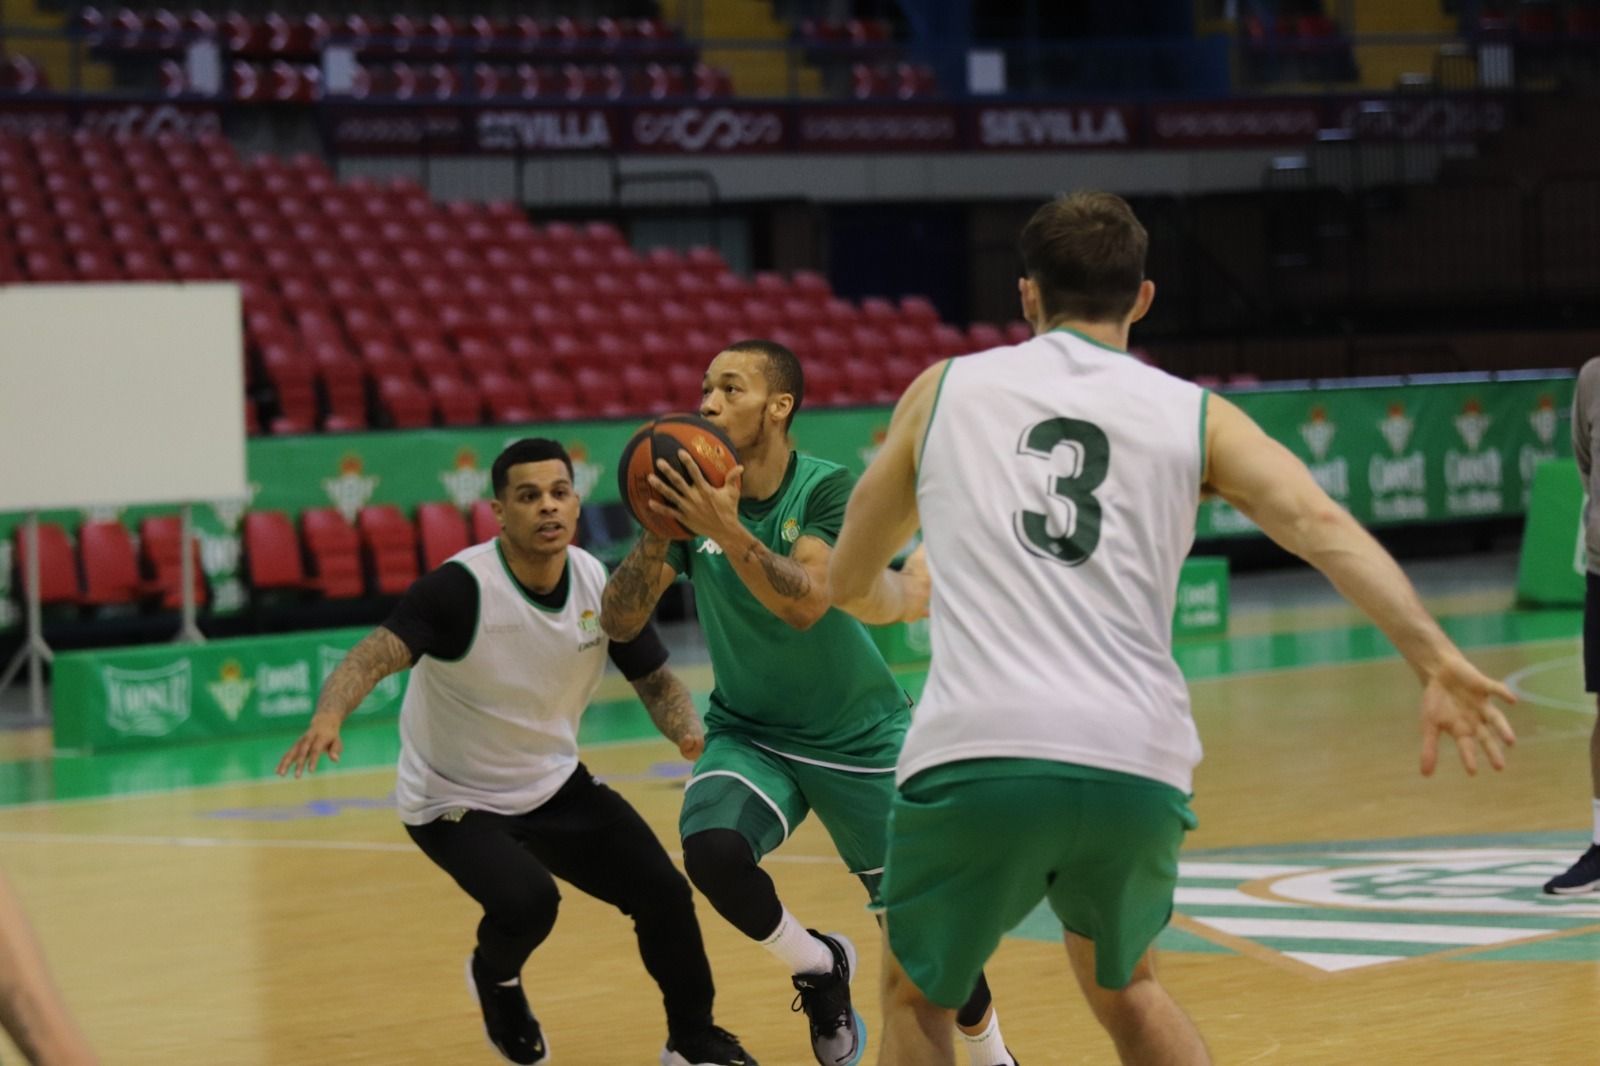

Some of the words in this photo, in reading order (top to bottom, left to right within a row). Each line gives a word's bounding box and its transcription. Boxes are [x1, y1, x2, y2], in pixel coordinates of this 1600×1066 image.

[478, 111, 610, 149] SEVILLA
[980, 109, 1127, 144] SEVILLA
[1013, 417, 1111, 567] 3
